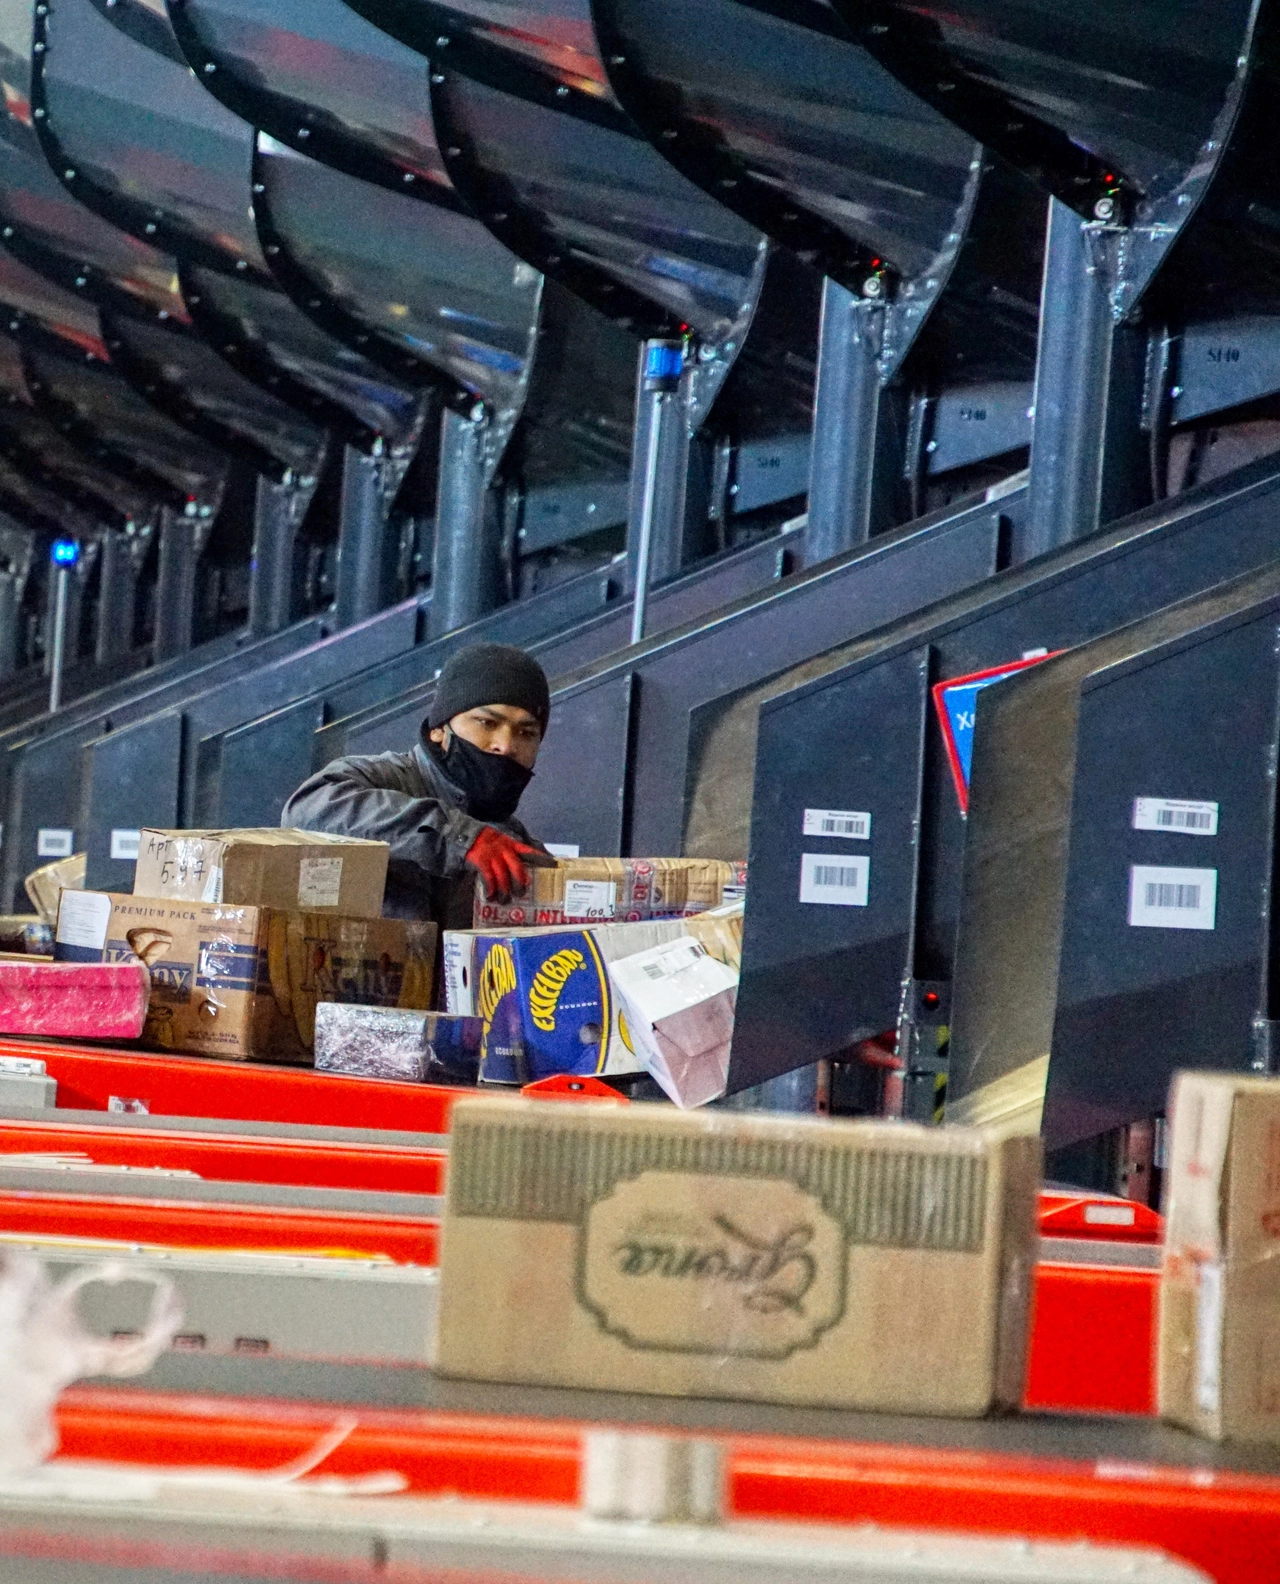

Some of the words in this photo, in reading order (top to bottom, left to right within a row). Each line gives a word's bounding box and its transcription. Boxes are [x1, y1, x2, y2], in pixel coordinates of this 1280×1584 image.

[114, 905, 166, 917] PREMIUM
[169, 910, 197, 921] PACK
[529, 948, 584, 1031] EXCELBAN
[559, 1001, 598, 1010] ECUADOR
